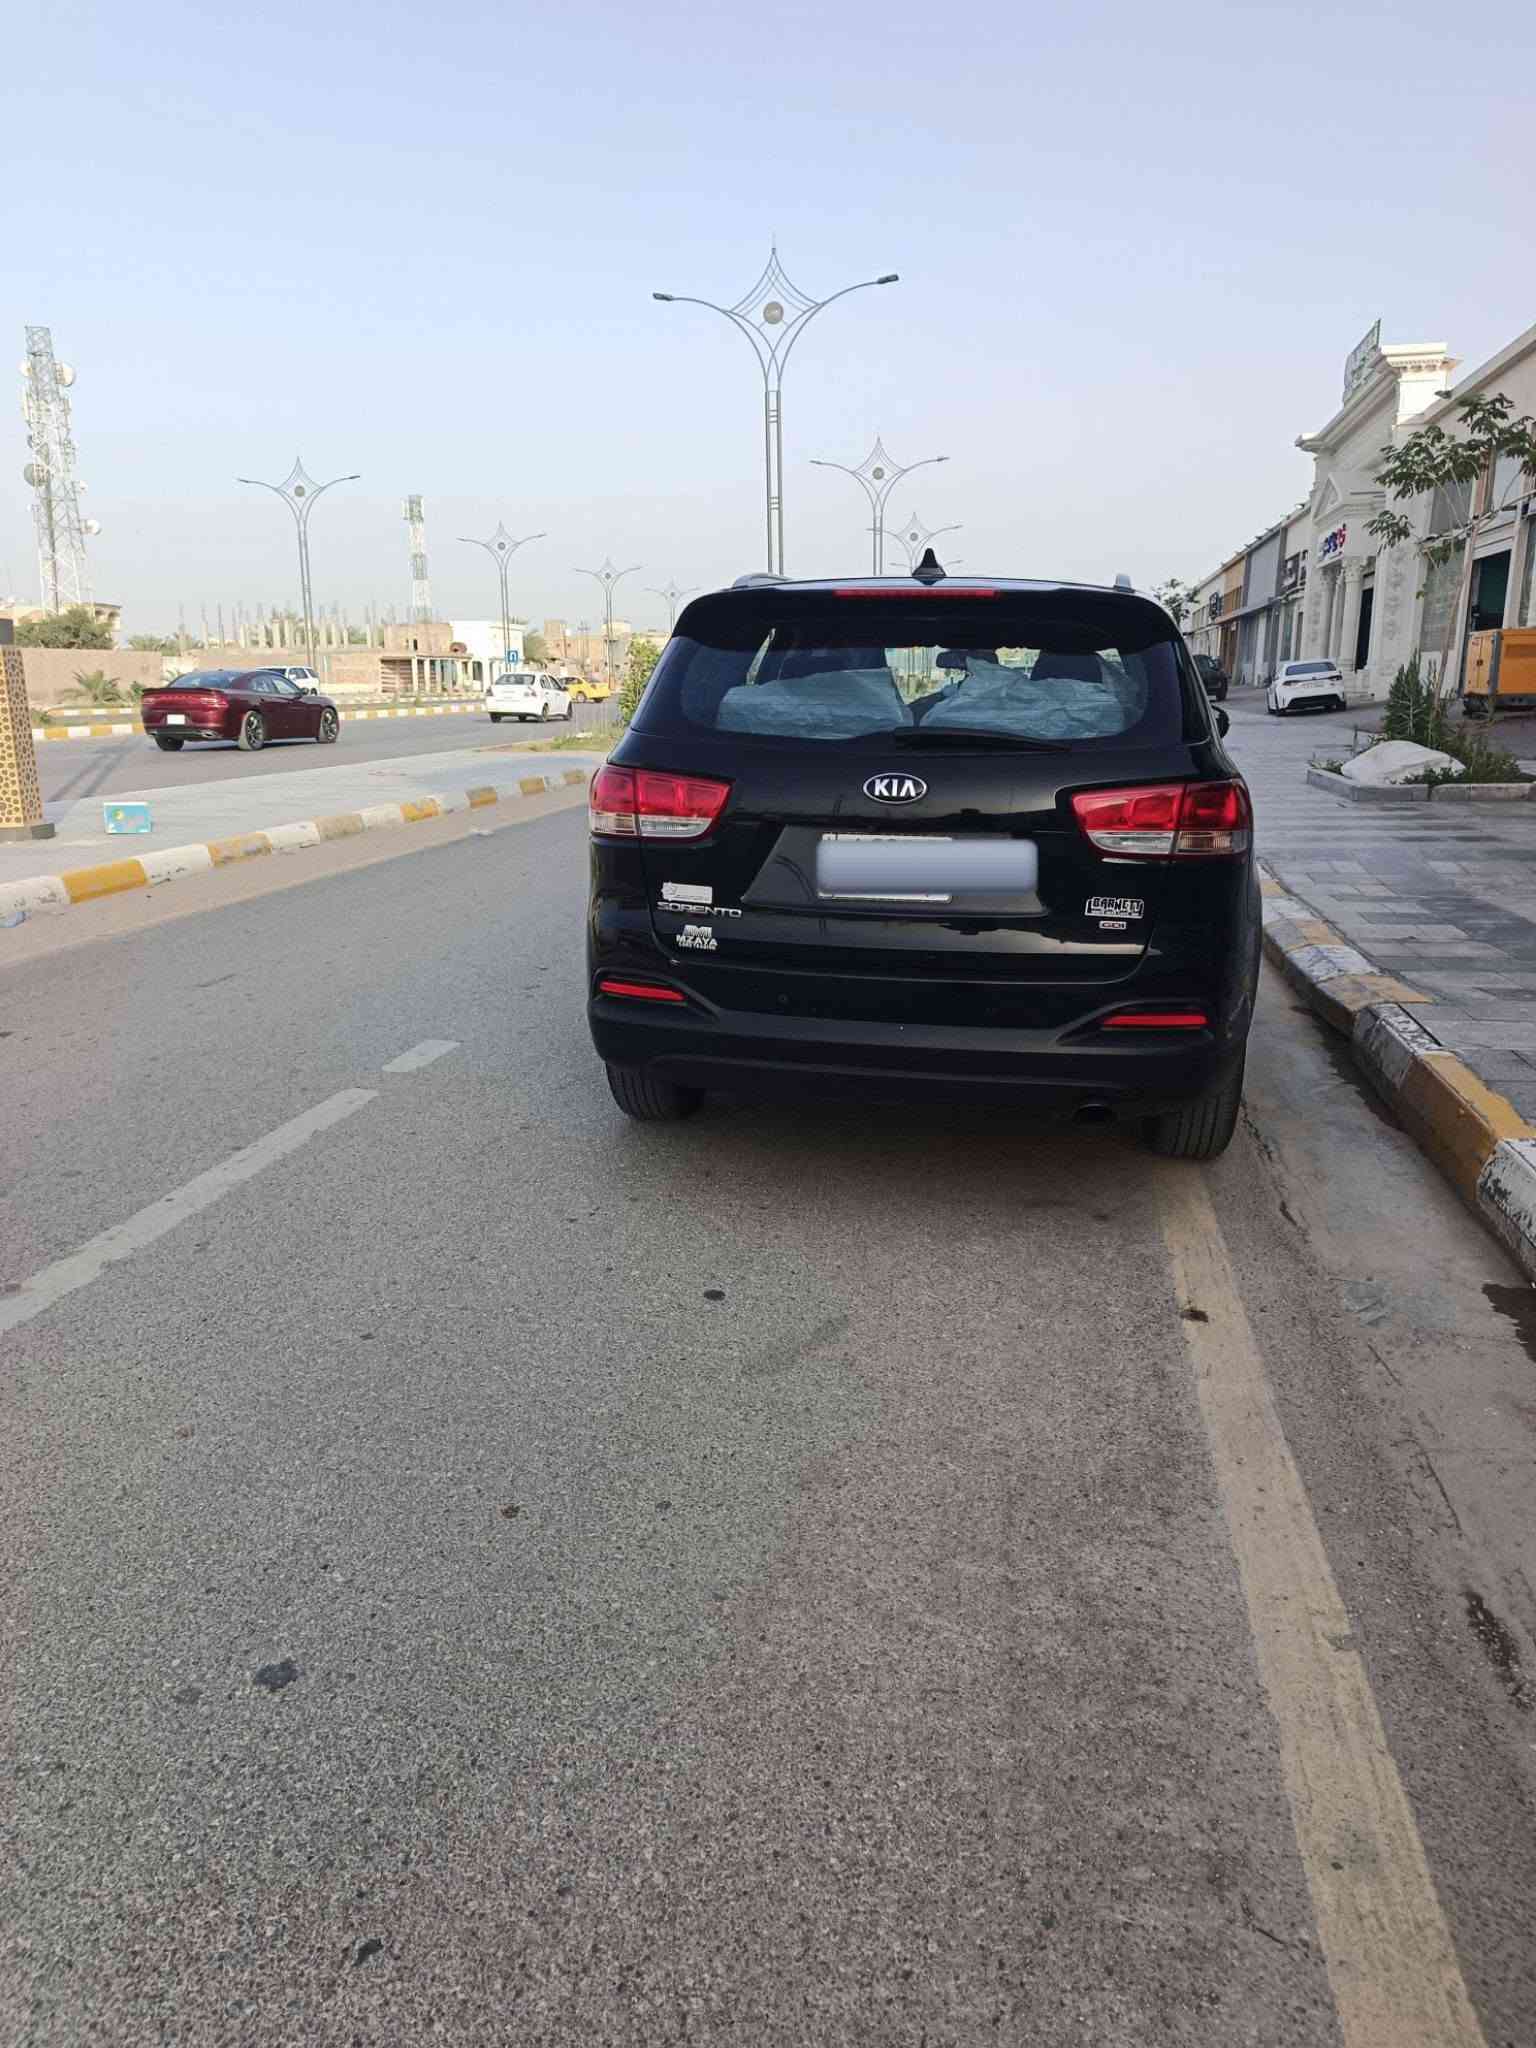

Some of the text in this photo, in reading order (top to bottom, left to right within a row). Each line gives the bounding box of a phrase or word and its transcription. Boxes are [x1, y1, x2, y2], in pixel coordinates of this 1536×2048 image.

[874, 779, 916, 797] KIA
[657, 901, 742, 918] SORENTO
[676, 934, 718, 946] MZAYA
